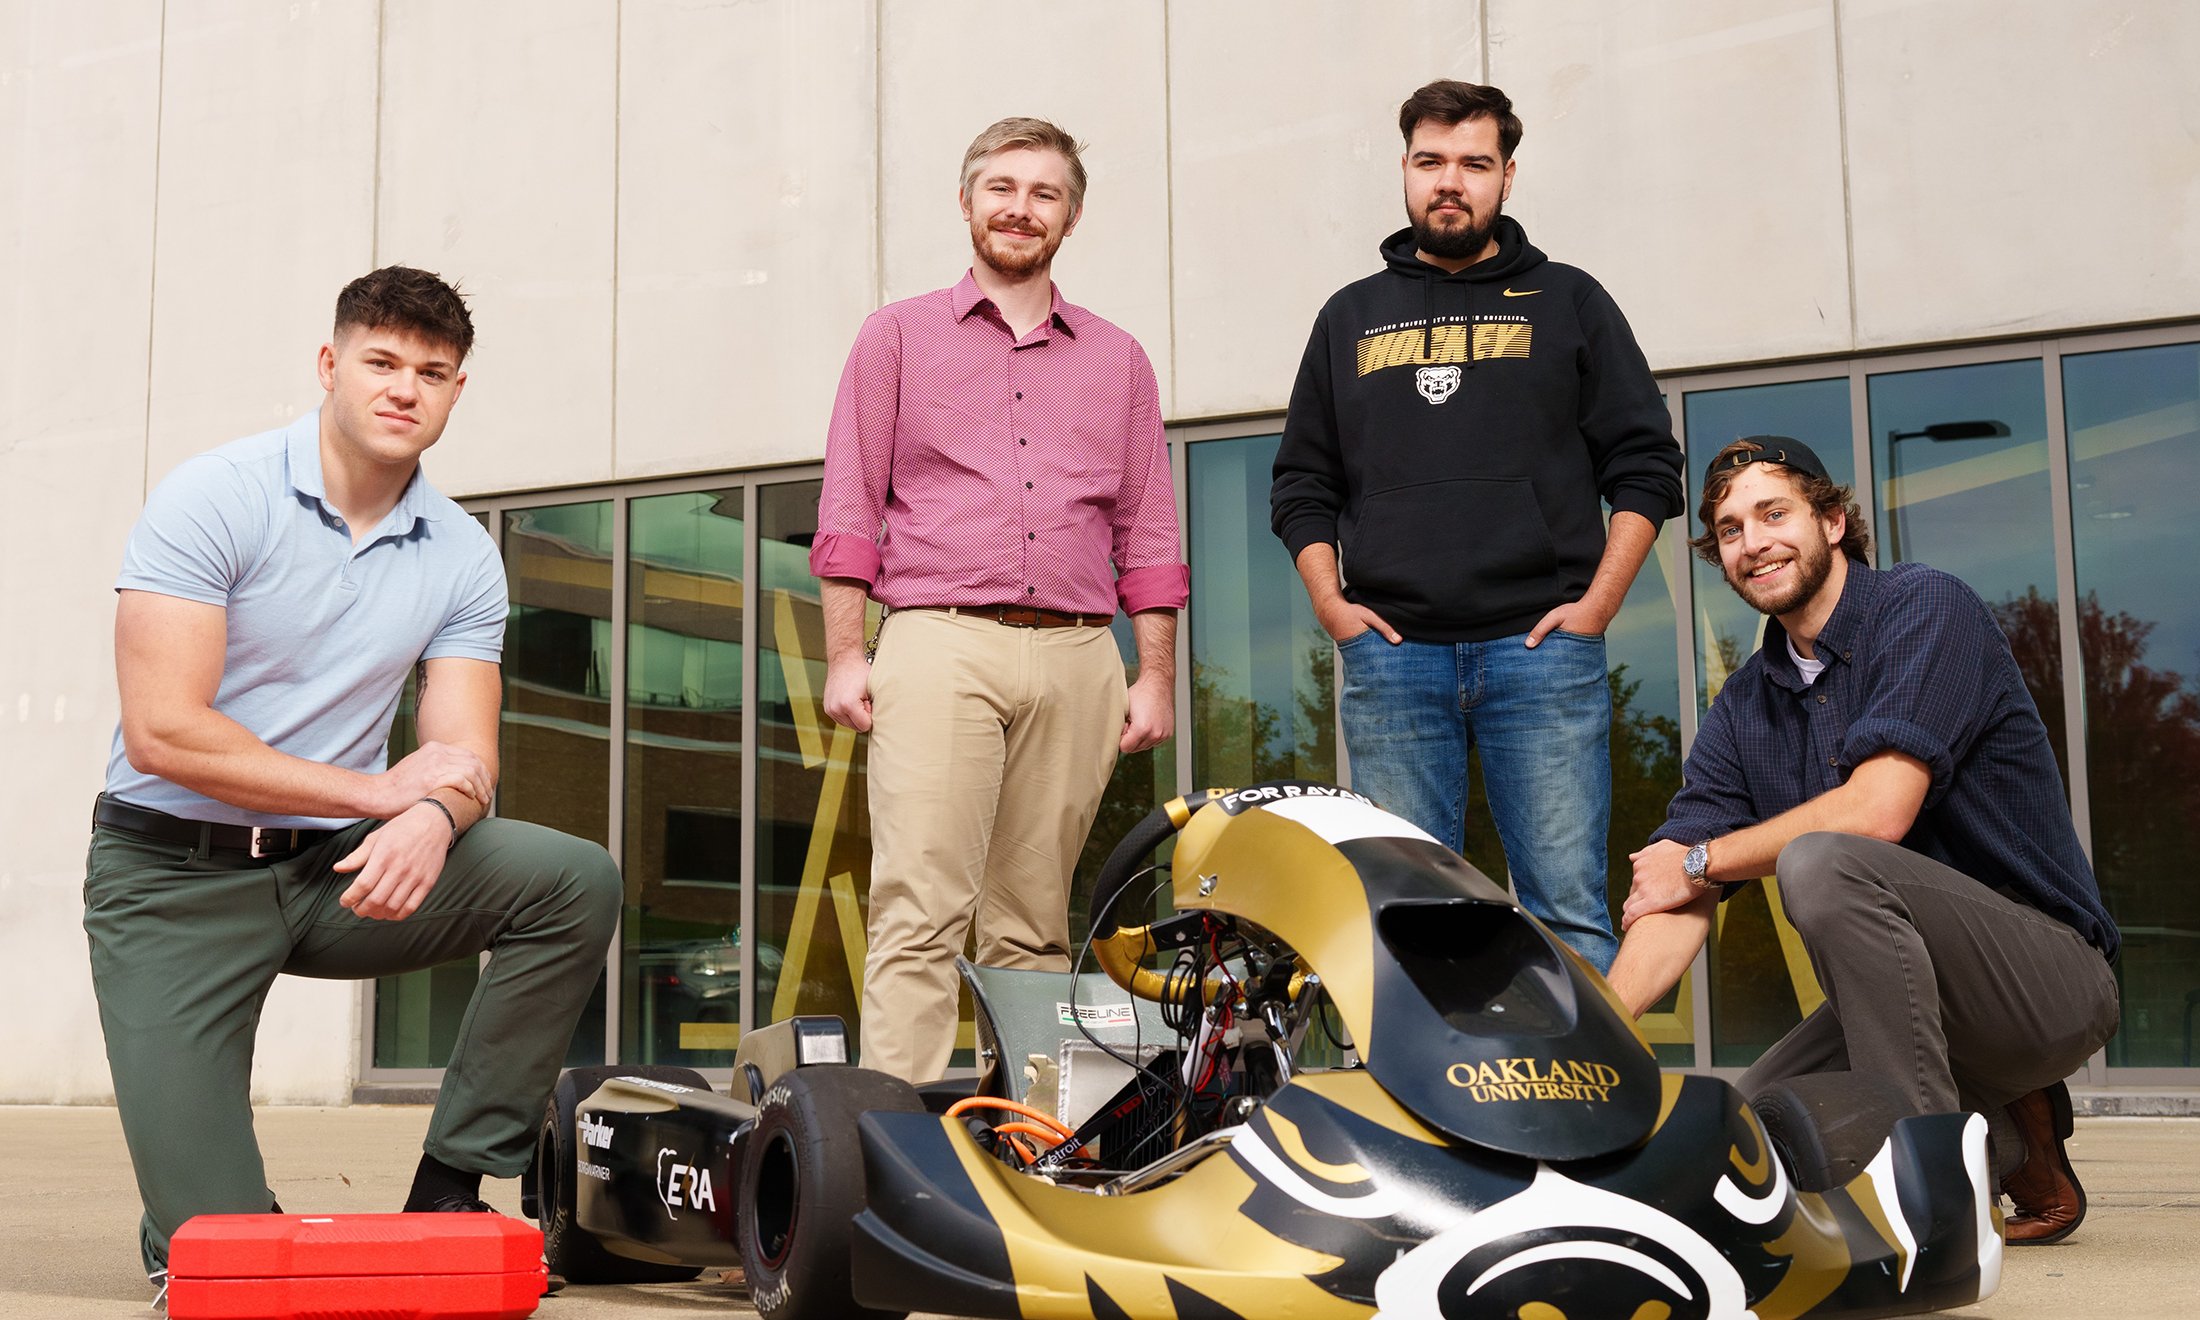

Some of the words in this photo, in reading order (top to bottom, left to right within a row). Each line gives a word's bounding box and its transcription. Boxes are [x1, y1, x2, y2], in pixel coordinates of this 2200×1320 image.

[1400, 316, 1446, 328] UNIVERITY
[1222, 786, 1282, 810] FOR
[1446, 1057, 1621, 1088] OAKLAND
[1469, 1082, 1610, 1103] UNIVERSITY
[578, 1112, 615, 1150] Parker
[1037, 1137, 1083, 1169] Detroit
[577, 1160, 611, 1181] BORGWARNER
[667, 1163, 717, 1213] ERA
